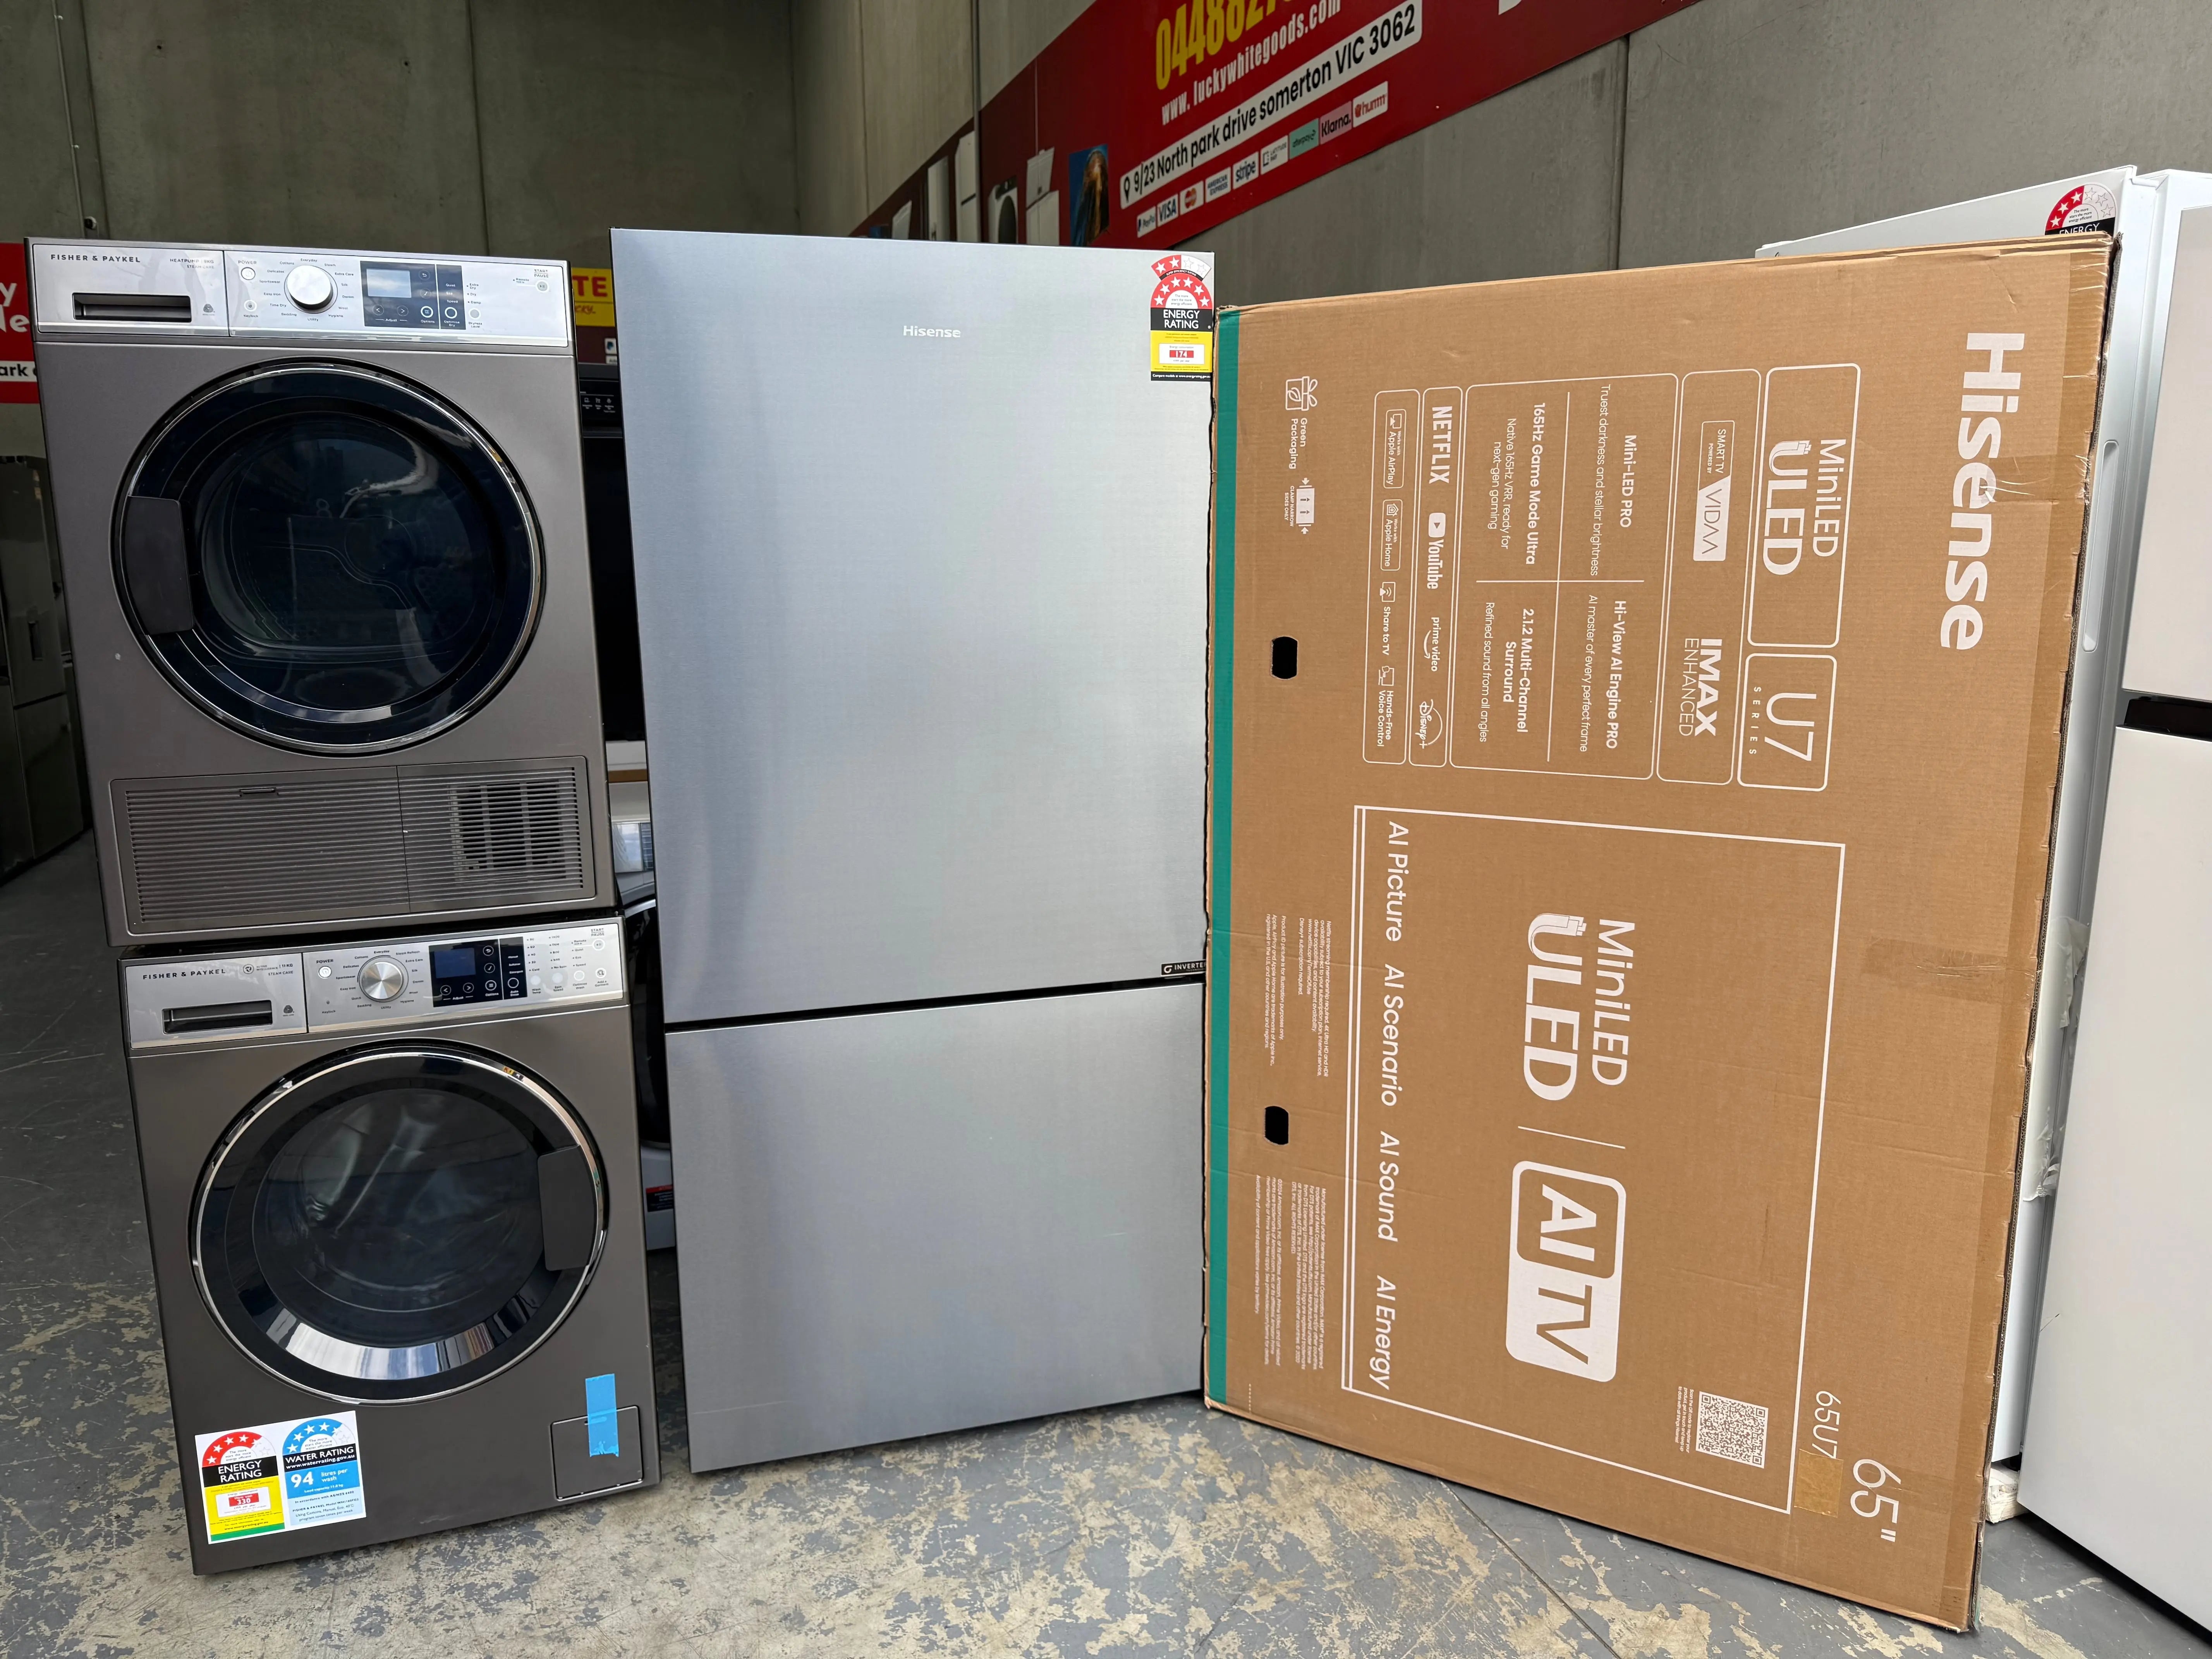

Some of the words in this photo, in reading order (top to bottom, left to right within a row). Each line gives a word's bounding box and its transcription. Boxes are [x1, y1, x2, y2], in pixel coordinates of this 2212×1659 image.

[1156, 0, 1291, 90] 04488
[1162, 91, 1190, 125] www.
[1194, 0, 1341, 106] luckywhitegoods.com
[1134, 161, 1155, 194] 9/23
[1158, 143, 1187, 179] North
[1191, 125, 1220, 167] park
[1223, 107, 1256, 141] drive
[1259, 60, 1331, 120] somerton
[1335, 37, 1365, 74] VIC
[1369, 3, 1415, 55] 3062
[1159, 199, 1176, 221] VISA
[1235, 161, 1255, 182] stripe
[1321, 113, 1351, 137] Klarna.
[1163, 309, 1200, 319] ENERGY
[1164, 320, 1199, 329] RATING
[903, 326, 961, 338] Hisense
[1600, 384, 1611, 416] Truest
[1506, 418, 1516, 451] Native
[1532, 403, 1545, 441] 165Hz
[1289, 419, 1298, 469] Packaging
[1388, 431, 1396, 455] Apple
[1429, 406, 1452, 484] NETFLIX
[1597, 419, 1608, 465] darkness
[1717, 429, 1726, 461] SMART
[1386, 457, 1395, 485] AirPlay
[1491, 441, 1501, 487] next-gen
[1504, 452, 1515, 480] 165Hz
[1530, 444, 1543, 487] Game
[1596, 467, 1605, 488] and
[1622, 435, 1637, 496] Mini-LED
[1716, 462, 1724, 473] TV
[1503, 481, 1514, 502] VRR,
[1594, 490, 1604, 520] stellar
[1763, 440, 1812, 575] ULED
[1812, 439, 1846, 557] MiniLED
[1941, 333, 2025, 650] Hisense
[1487, 489, 1499, 529] gaming
[1500, 503, 1511, 533] ready
[1528, 490, 1541, 528] Mode
[1620, 500, 1633, 527] PRO
[1501, 535, 1510, 550] for
[1526, 532, 1539, 564] Ultra
[1590, 523, 1602, 576] brightness
[1427, 539, 1444, 589] YouTube
[1589, 595, 1598, 604] AI
[1432, 617, 1441, 645] prime
[1484, 602, 1495, 638] Refined
[1522, 608, 1534, 635] 2.1.2
[1586, 606, 1596, 642] master
[1612, 601, 1626, 654] Hi-View
[1382, 645, 1389, 655] TV
[1383, 634, 1389, 642] to
[1586, 643, 1595, 654] of
[1431, 647, 1440, 672] video
[1484, 641, 1492, 671] sound
[1503, 642, 1516, 702] Surround
[1582, 656, 1593, 683] every
[1611, 657, 1623, 670] AI
[1482, 672, 1492, 696] from
[1517, 638, 1532, 732] Multi-Channel
[1606, 673, 1622, 719] Engine
[1679, 638, 1699, 736] ENHANCED
[1695, 639, 1723, 736] IMAX
[1386, 690, 1394, 740] Hands-Free
[1481, 697, 1490, 709] all
[1582, 685, 1591, 721] perfect
[1478, 710, 1489, 742] angles
[1580, 723, 1590, 752] frame
[1606, 722, 1619, 749] PRO
[1749, 687, 1761, 755] SERIES
[1764, 692, 1817, 761] U7
[1388, 821, 1409, 845] AI
[1386, 853, 1409, 942] Picture
[1384, 963, 1405, 988] AI
[1523, 912, 1587, 1101] ULED
[1591, 919, 1635, 1085] MiniLED
[1381, 994, 1404, 1106] Scenario
[1380, 1130, 1400, 1156] AI
[1378, 1161, 1399, 1242] Sound
[1539, 1183, 1597, 1262] AI
[1376, 1275, 1396, 1300] AI
[1536, 1285, 1593, 1365] TV
[1369, 1306, 1395, 1390] Energy
[1812, 1390, 1841, 1459] 65U7
[218, 1460, 262, 1474] ENERGY
[285, 1453, 317, 1463] WATER
[320, 1446, 354, 1459] RATING
[286, 1455, 355, 1469] www.waterrating.gov.au
[220, 1470, 262, 1483] RATING
[291, 1472, 314, 1488] 94
[1850, 1459, 1901, 1542] 65"
